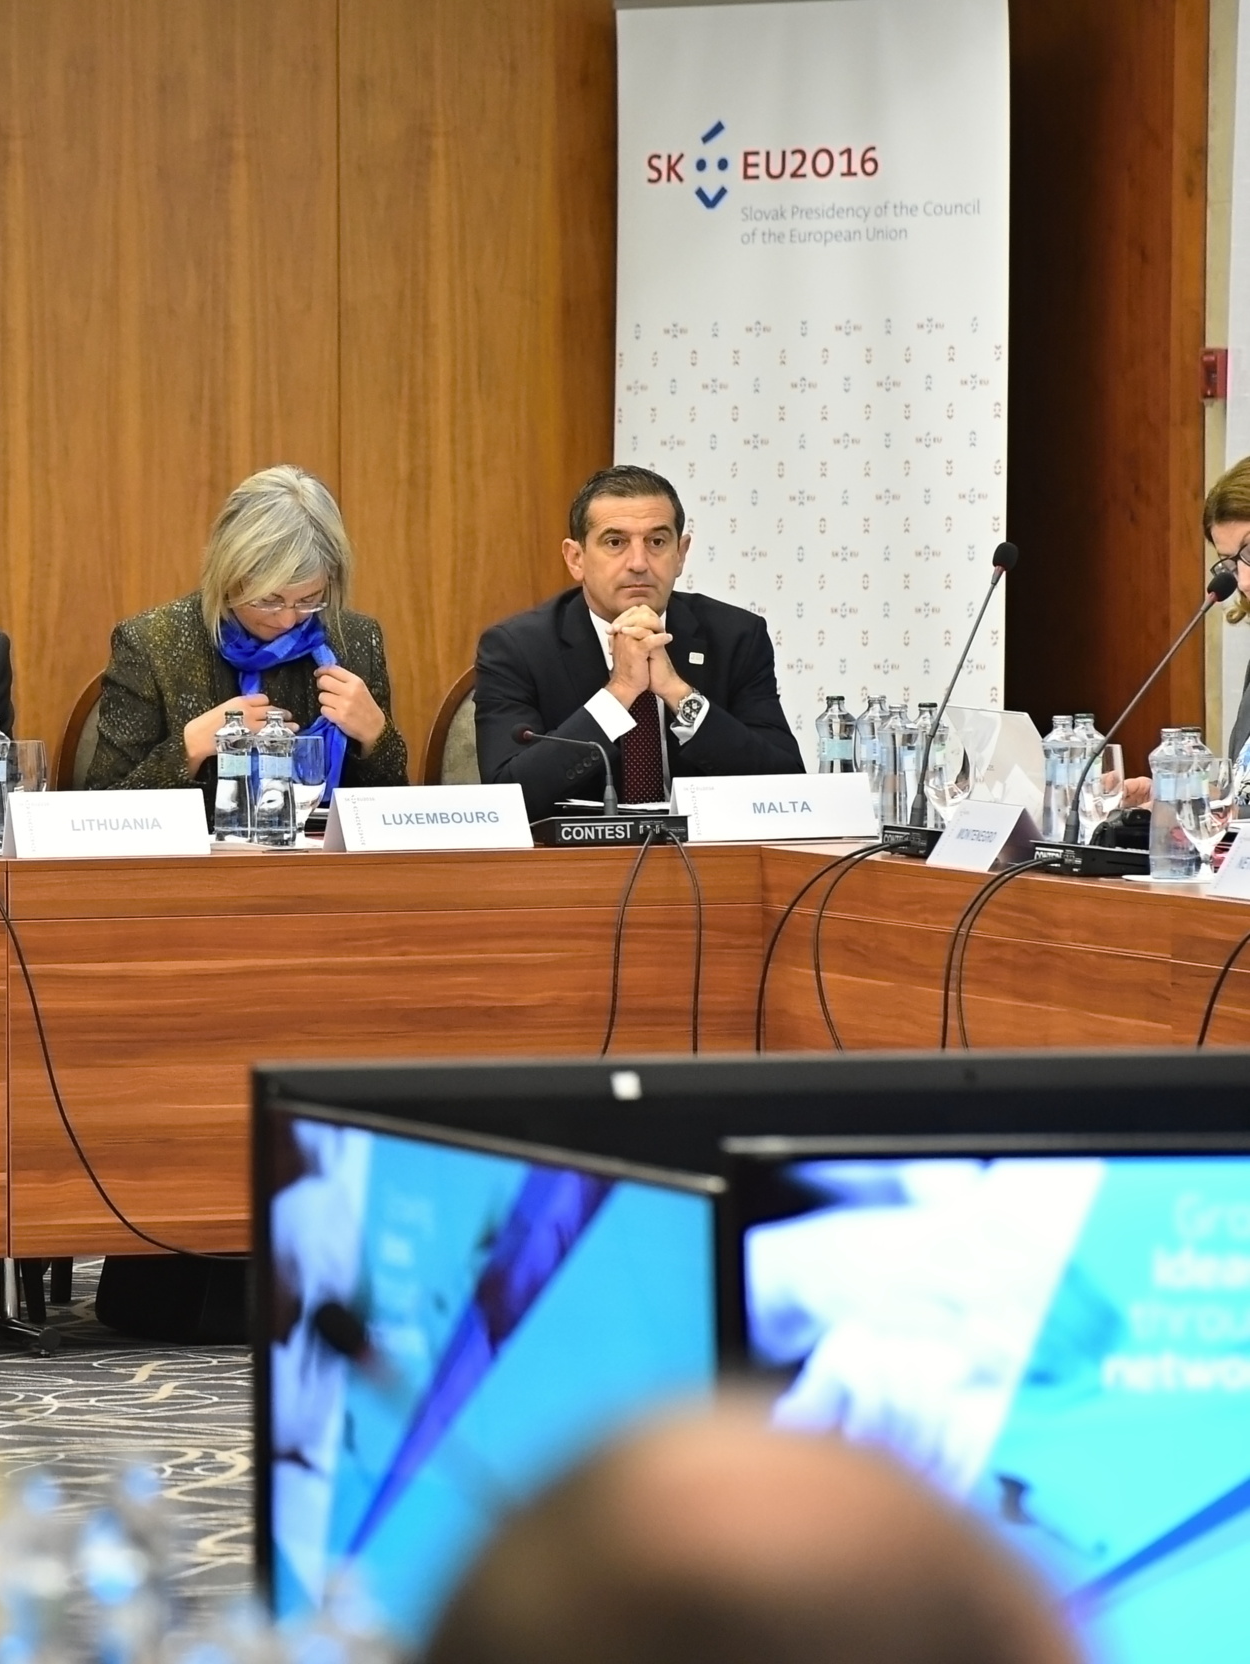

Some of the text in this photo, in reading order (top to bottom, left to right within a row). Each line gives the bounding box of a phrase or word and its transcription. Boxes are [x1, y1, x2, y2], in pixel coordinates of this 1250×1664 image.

[646, 145, 880, 184] SK EU2016
[740, 198, 981, 223] Slovak Presidency of the Council
[740, 225, 908, 247] of the European Union
[752, 801, 812, 814] MALTA
[70, 817, 163, 832] LITHUANIA
[381, 811, 500, 826] LUXEMBOURG
[561, 822, 634, 840] CONTEST
